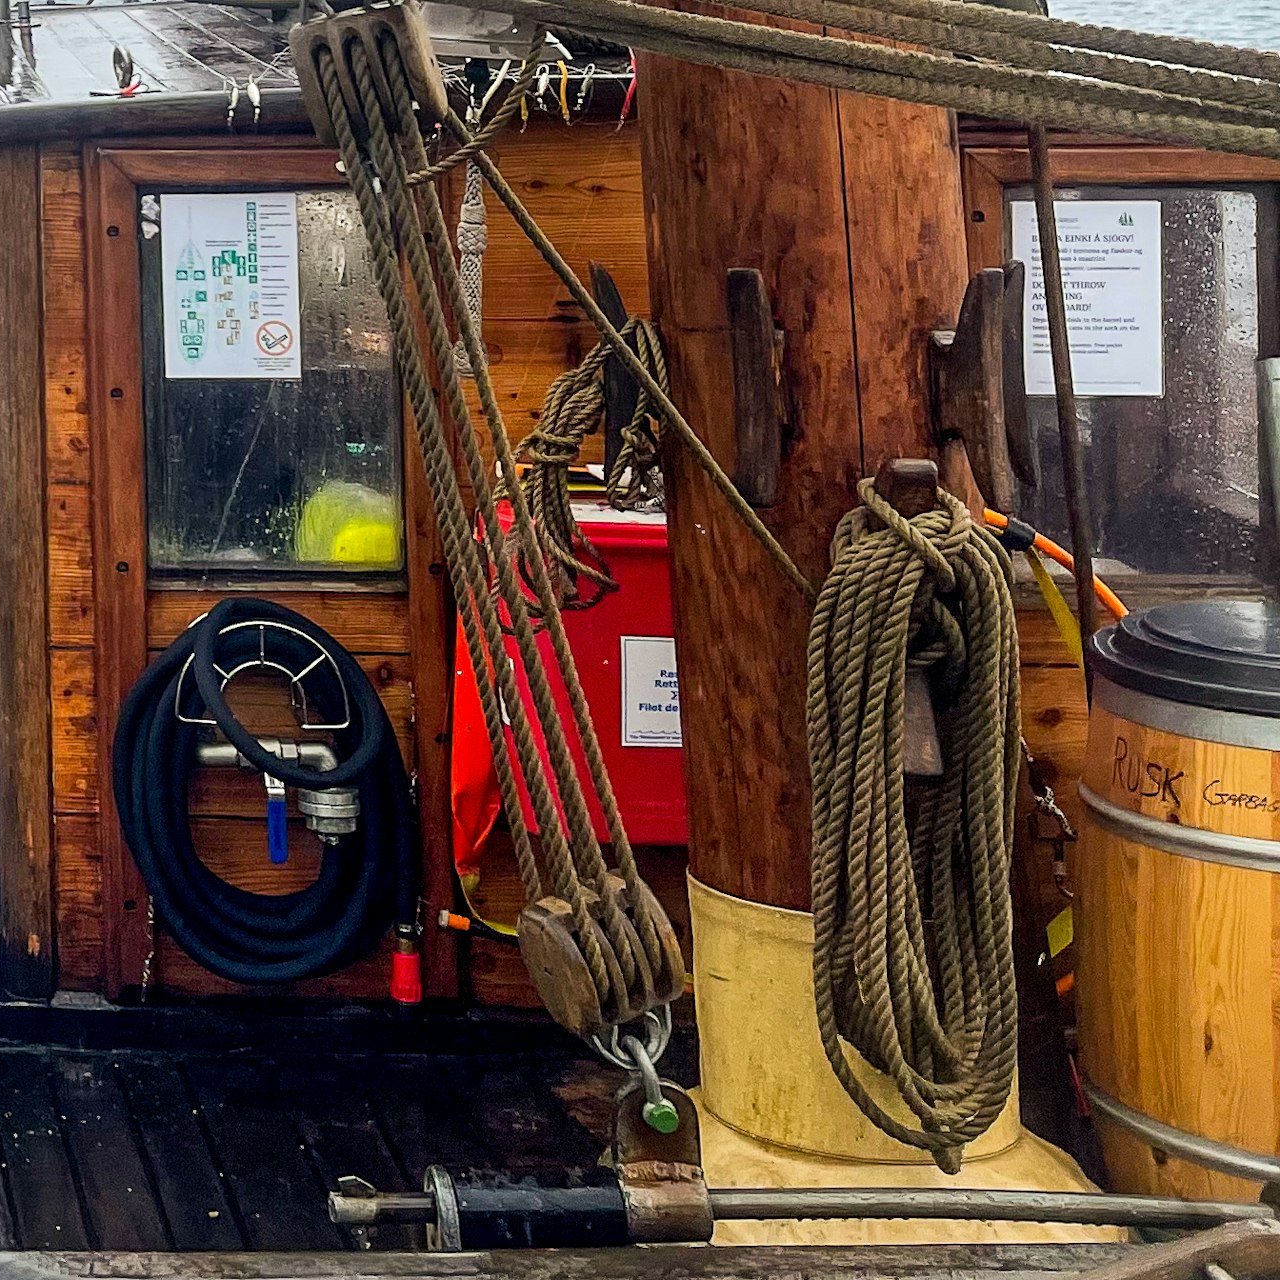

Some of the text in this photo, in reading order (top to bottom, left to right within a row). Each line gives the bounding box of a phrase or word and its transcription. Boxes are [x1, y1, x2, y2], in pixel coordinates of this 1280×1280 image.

[1065, 234, 1091, 243] EINKI
[1070, 281, 1106, 289] THROW
[1032, 292, 1083, 300] ANING
[639, 703, 678, 712] Filet de
[1111, 736, 1185, 808] RUSK
